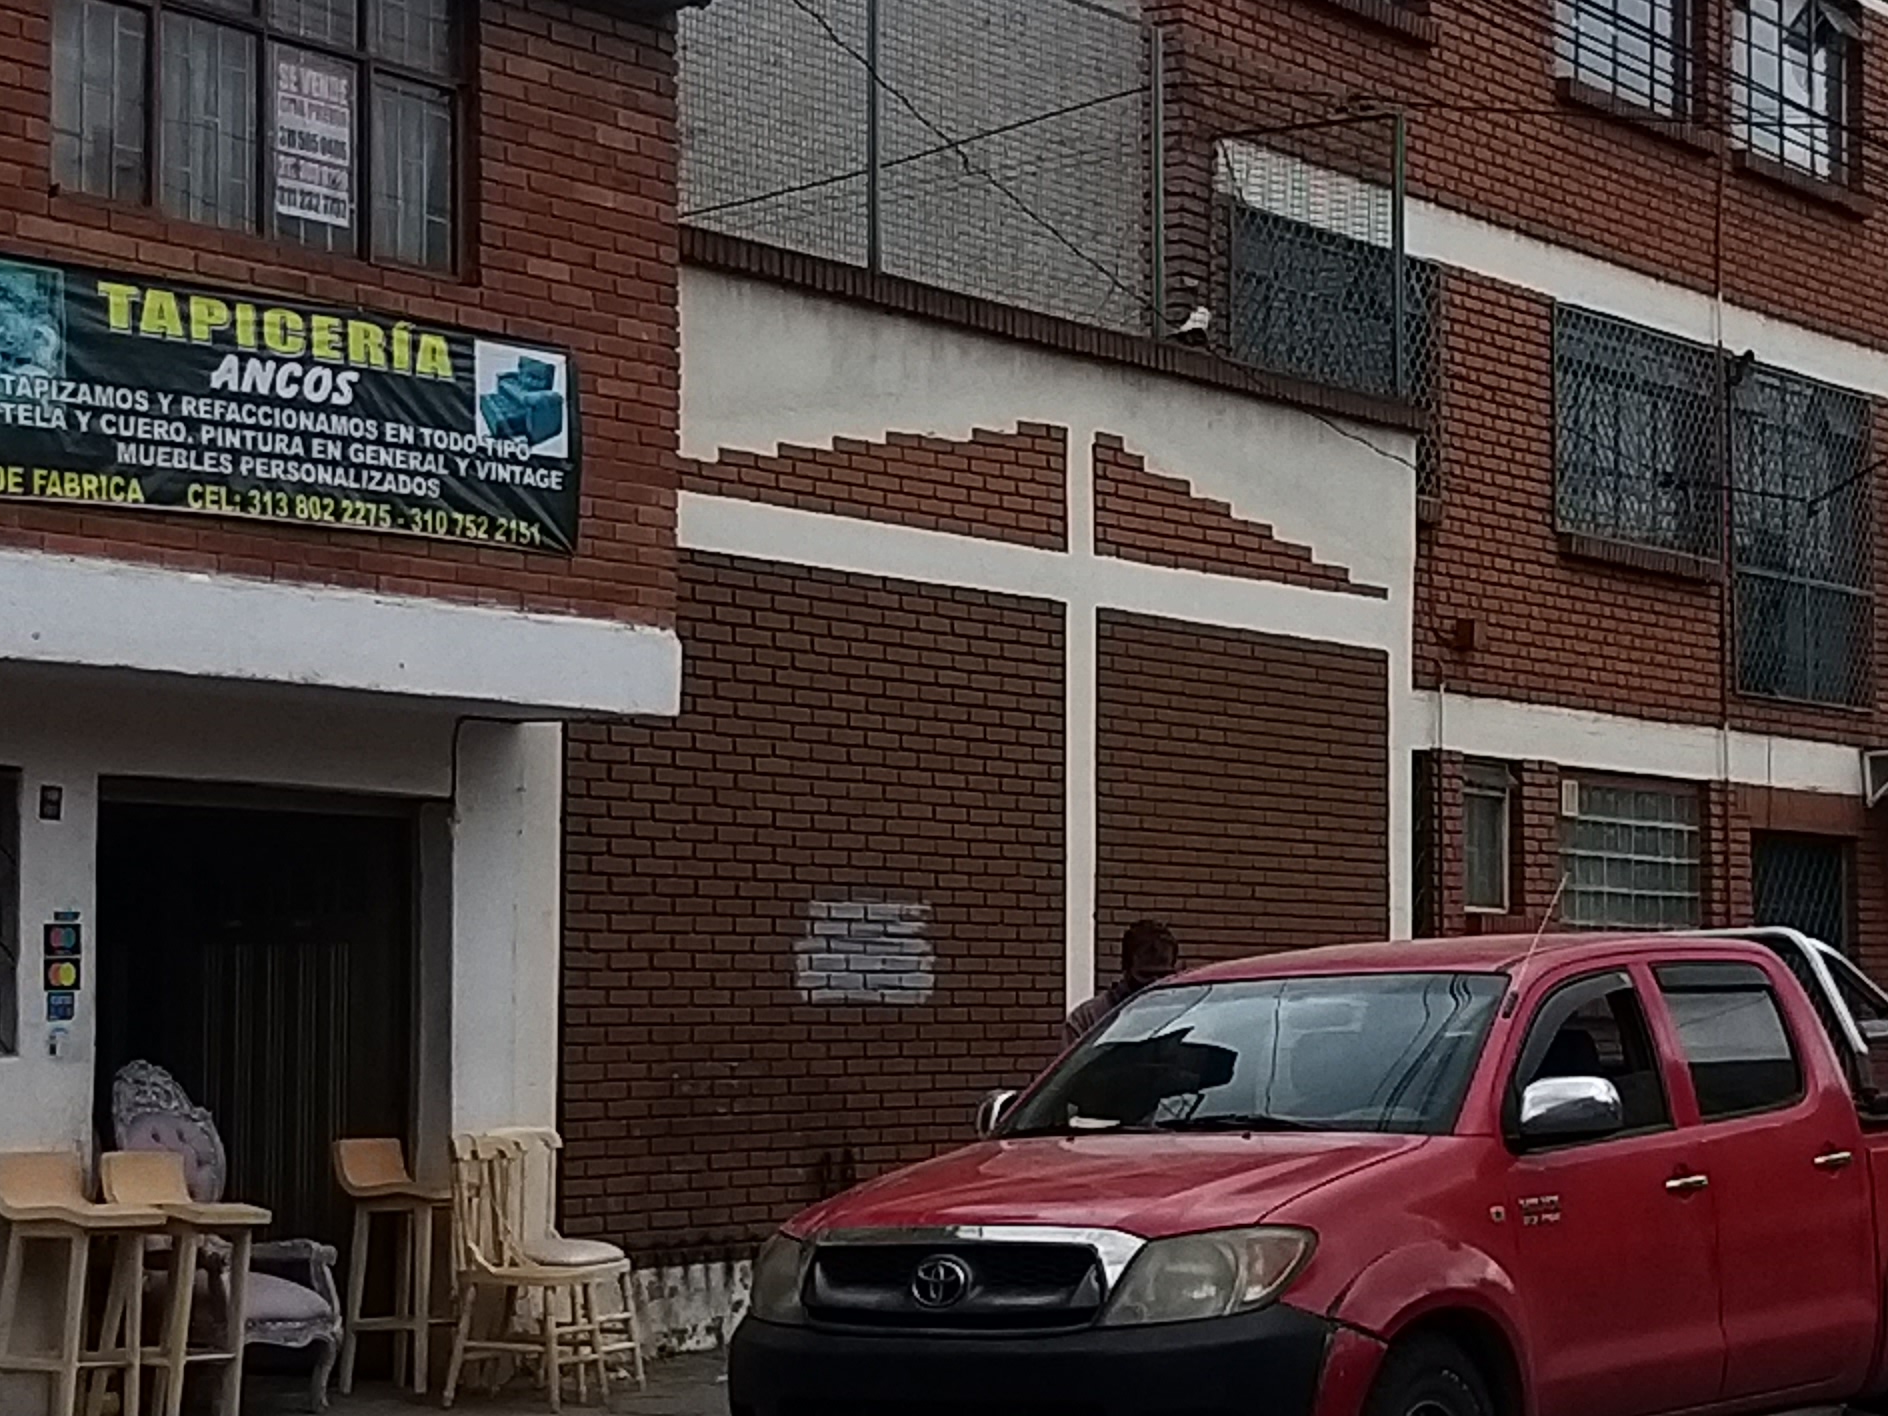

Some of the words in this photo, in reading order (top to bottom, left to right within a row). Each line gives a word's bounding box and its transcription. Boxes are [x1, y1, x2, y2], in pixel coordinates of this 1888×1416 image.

[278, 62, 297, 92] SE
[97, 281, 456, 383] TAPICERÍA
[210, 353, 360, 406] ANCOS
[0, 373, 150, 412] TAPIZAMOS
[156, 392, 175, 415] Y
[181, 395, 379, 441] REFACCIONAMOS
[384, 421, 414, 445] EN
[419, 426, 478, 455] TODO
[484, 436, 531, 462] TIPO
[1, 402, 67, 431] TELA
[74, 410, 93, 433] Y
[99, 413, 194, 445] CUERO.
[201, 423, 305, 457] PINTURA
[311, 438, 342, 461] EN
[349, 443, 449, 476] GENERAL
[454, 456, 471, 477] Y
[475, 459, 564, 491] VINTAGE
[116, 441, 233, 474] MUEBLES
[239, 455, 441, 499] PERSONALIZADOS
[32, 467, 146, 504] FABRICA
[187, 483, 241, 513] CEL:
[247, 489, 290, 518] 313
[295, 493, 335, 523] 802
[341, 499, 392, 528] 2275
[410, 507, 448, 535] 310
[451, 511, 489, 540] 752
